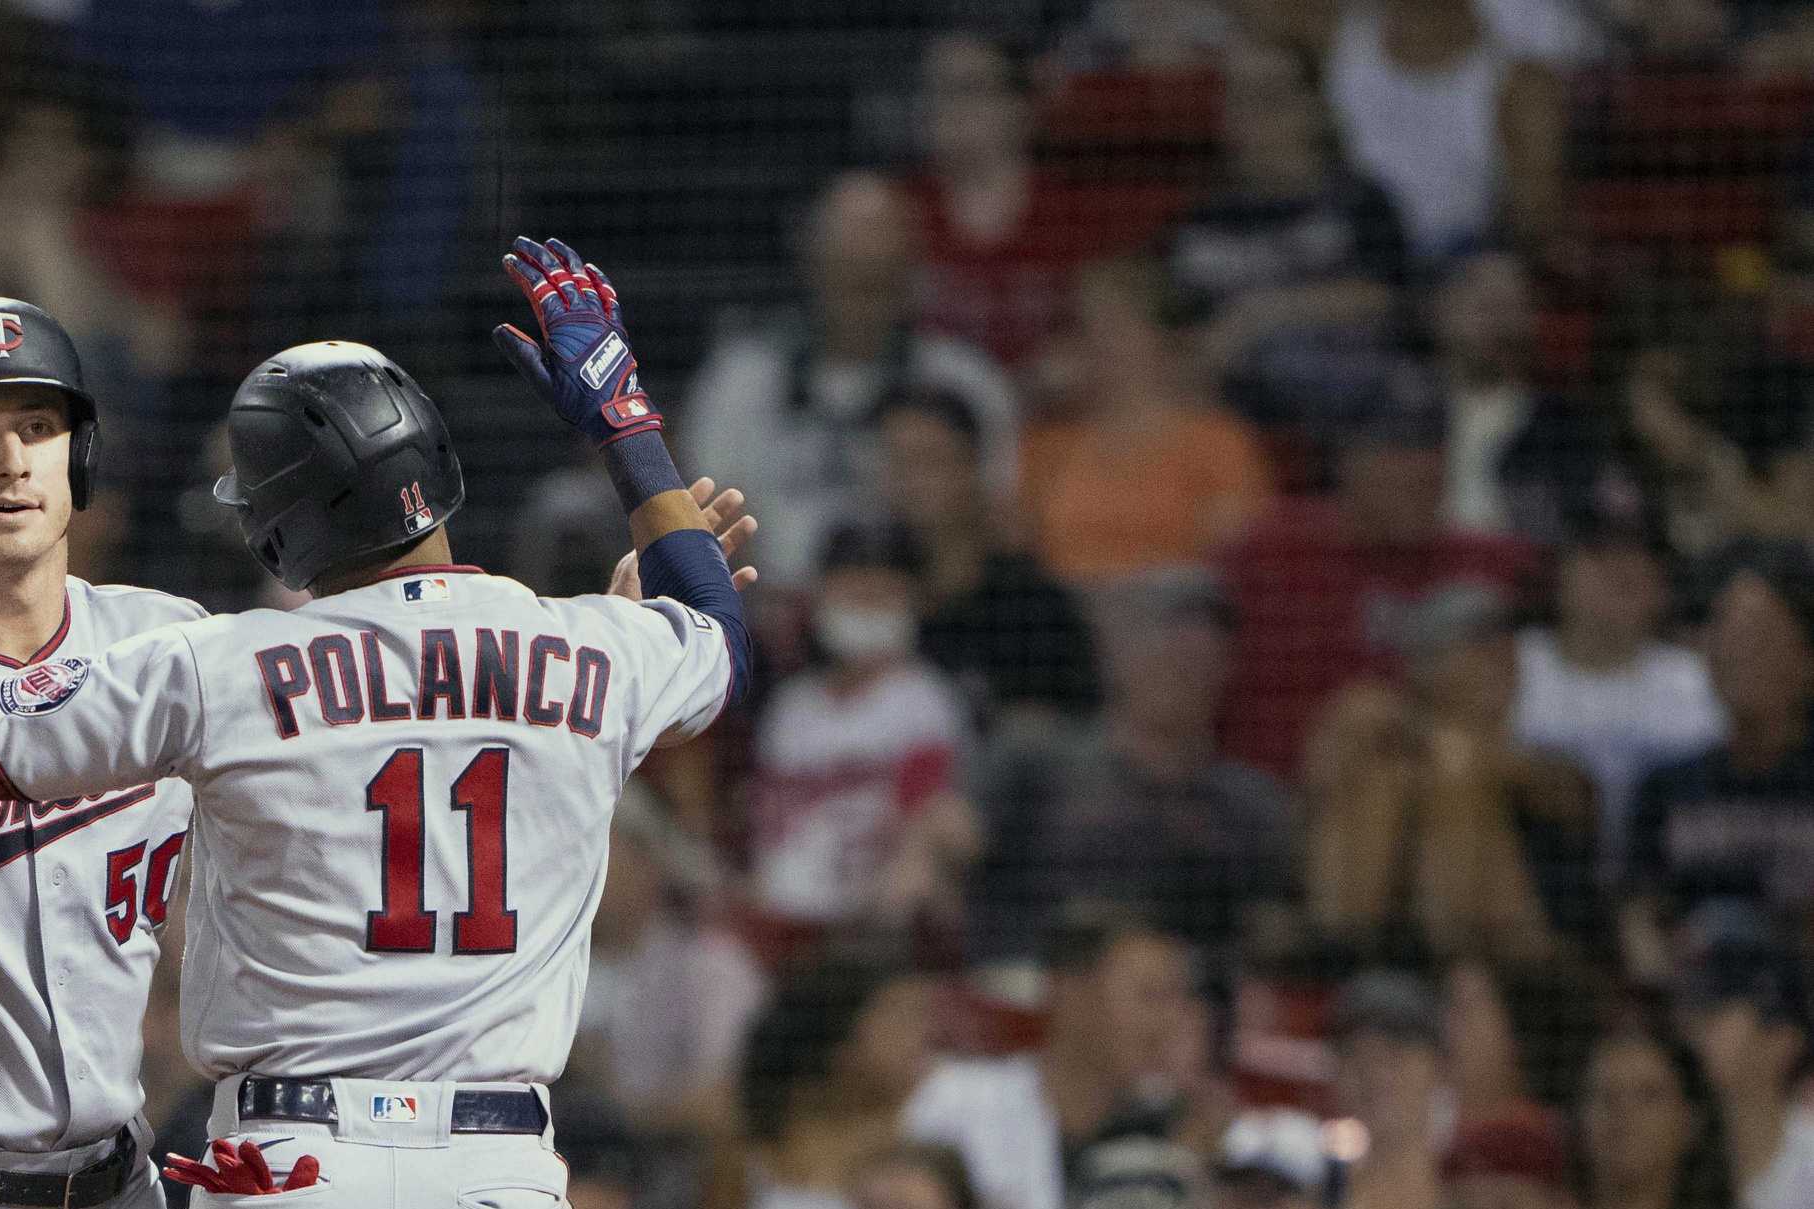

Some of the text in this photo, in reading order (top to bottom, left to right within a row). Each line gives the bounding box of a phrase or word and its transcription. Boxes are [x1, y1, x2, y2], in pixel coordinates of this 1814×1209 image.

[400, 481, 425, 515] 11
[255, 627, 612, 740] POLANCO
[105, 831, 186, 947] 50
[365, 747, 518, 955] 11
